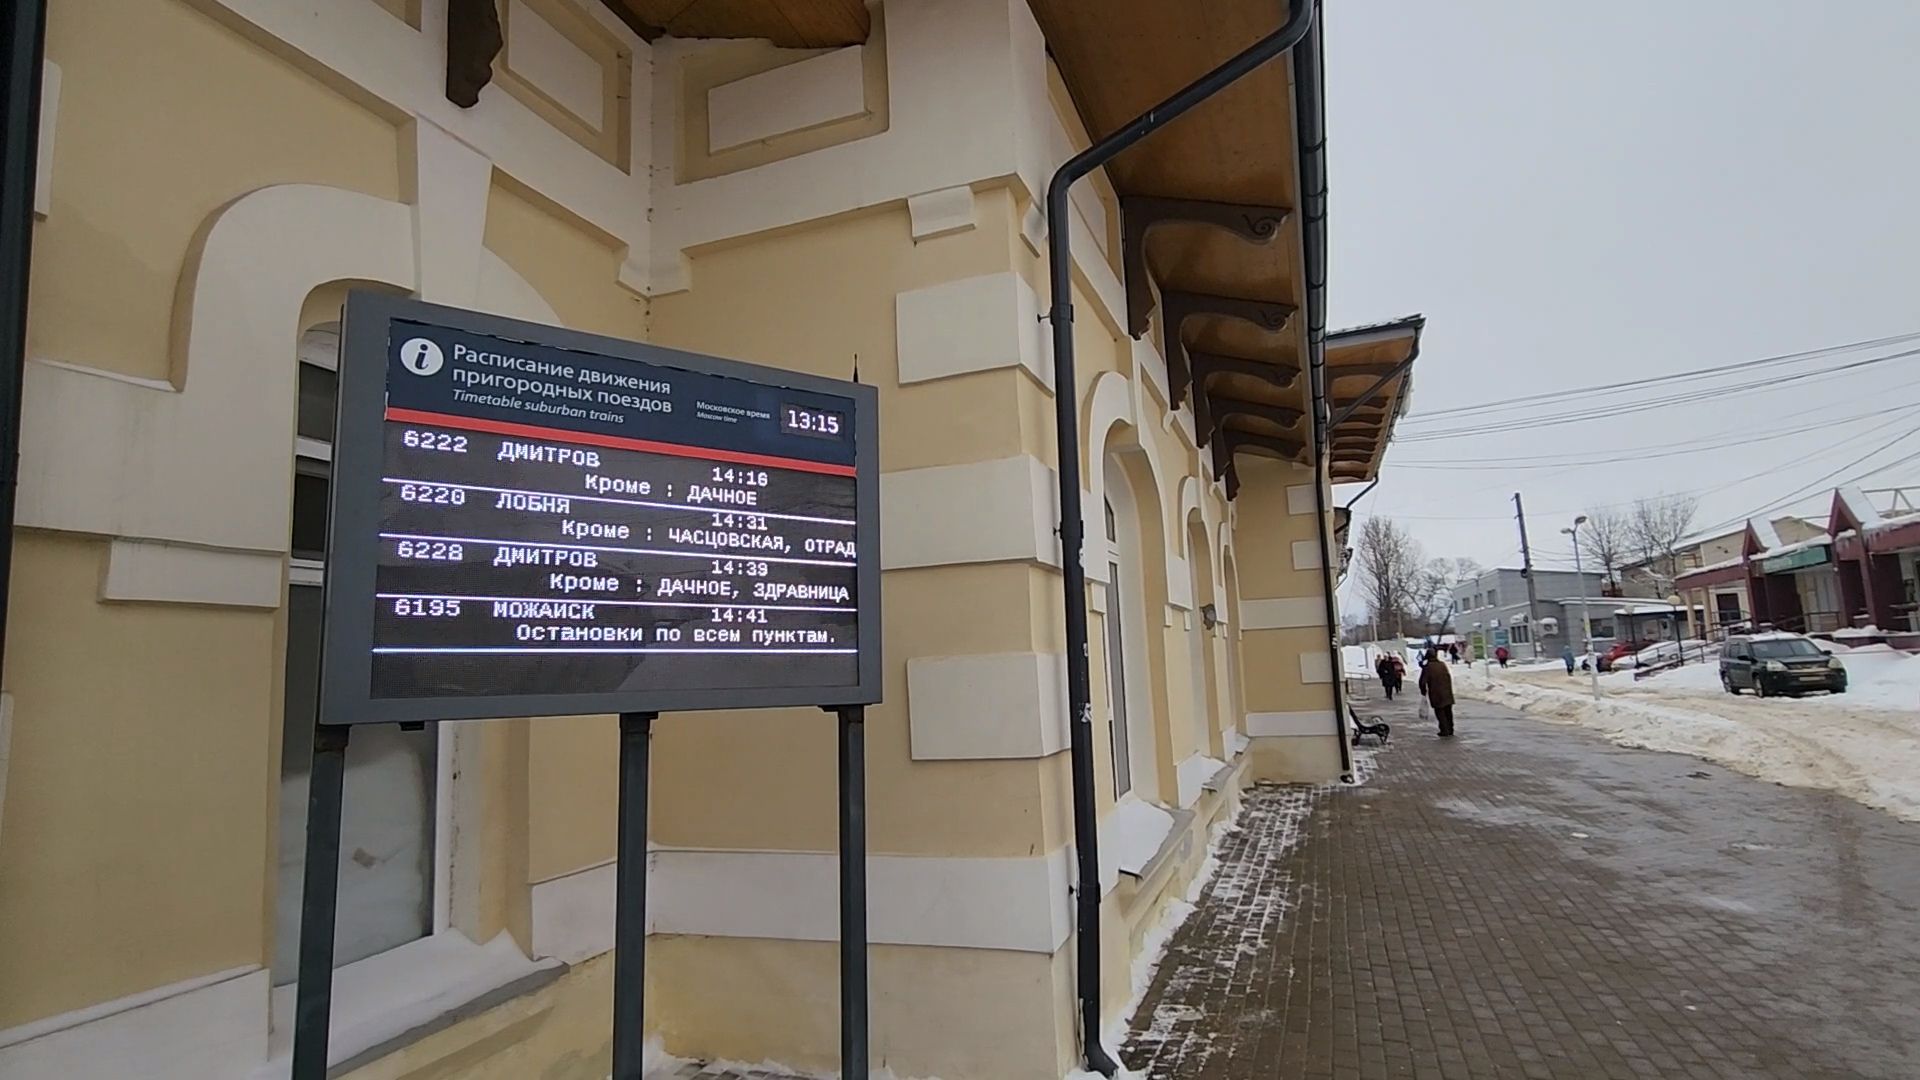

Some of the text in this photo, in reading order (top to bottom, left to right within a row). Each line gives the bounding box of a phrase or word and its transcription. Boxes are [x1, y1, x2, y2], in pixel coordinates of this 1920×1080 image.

[453, 344, 671, 395] Расписание движения
[453, 368, 673, 413] пригородных поездов
[453, 389, 624, 424] Timetable suburban trains
[696, 401, 770, 420] Московское время
[697, 411, 738, 424] Moscow time
[788, 410, 840, 434] 13:15
[403, 430, 768, 487] 6222 ДМИТРОВ 14:16
[585, 474, 651, 495] Кроме
[687, 484, 757, 506] ДАЧНОЕ
[400, 484, 768, 531] 6220 ЛОБНЯ 14:31
[561, 519, 630, 539] Кроме
[668, 527, 791, 553] ЧАСЦОВСКАЯ,
[804, 539, 857, 557] ОТРАД
[397, 541, 768, 576] 6228 ДМИТРОВ 14:39
[549, 573, 619, 593] Кроме
[657, 578, 739, 598] ДАЧНОЕ,
[753, 582, 850, 602] ЗДРАВНИЦА
[395, 599, 461, 616] 6195
[711, 608, 768, 623] 14:41
[515, 624, 836, 645] Остановки по всем пунктам.
